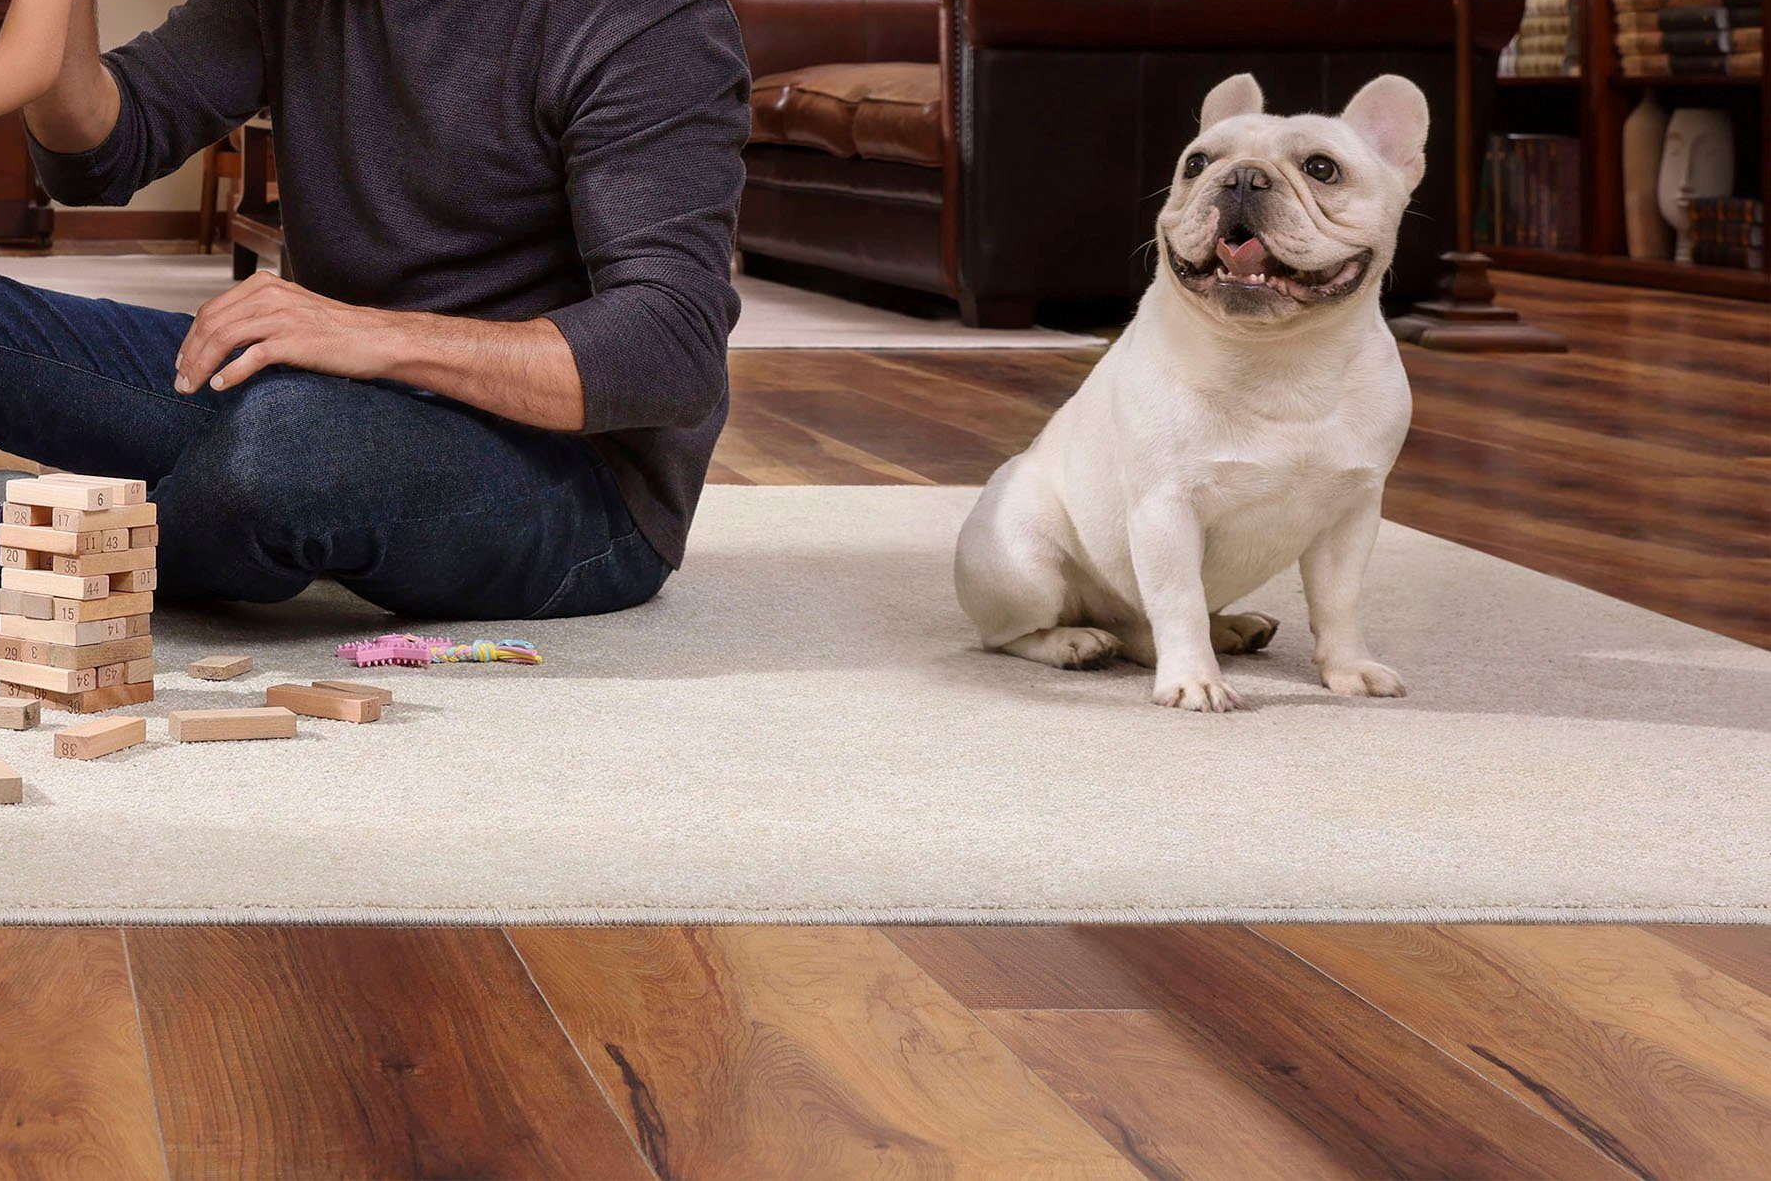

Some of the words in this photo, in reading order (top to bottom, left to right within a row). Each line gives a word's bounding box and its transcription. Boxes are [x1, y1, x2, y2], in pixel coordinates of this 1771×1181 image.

[97, 492, 104, 506] 6
[14, 511, 27, 525] 28
[58, 514, 70, 527] 17
[84, 537, 96, 550] 11
[106, 536, 118, 549] 43
[6, 548, 19, 563] 20
[64, 560, 77, 574] 35
[140, 572, 151, 585] 10
[87, 582, 100, 596] 44
[62, 607, 74, 621] 15
[108, 623, 119, 636] 14
[132, 620, 139, 633] 7
[4, 647, 18, 660] 29
[30, 646, 38, 659] 3
[77, 673, 90, 687] 34
[105, 668, 118, 681] 45
[8, 683, 21, 697] 37
[34, 687, 47, 700] 40
[67, 700, 81, 714] 30
[61, 741, 77, 757] 38
